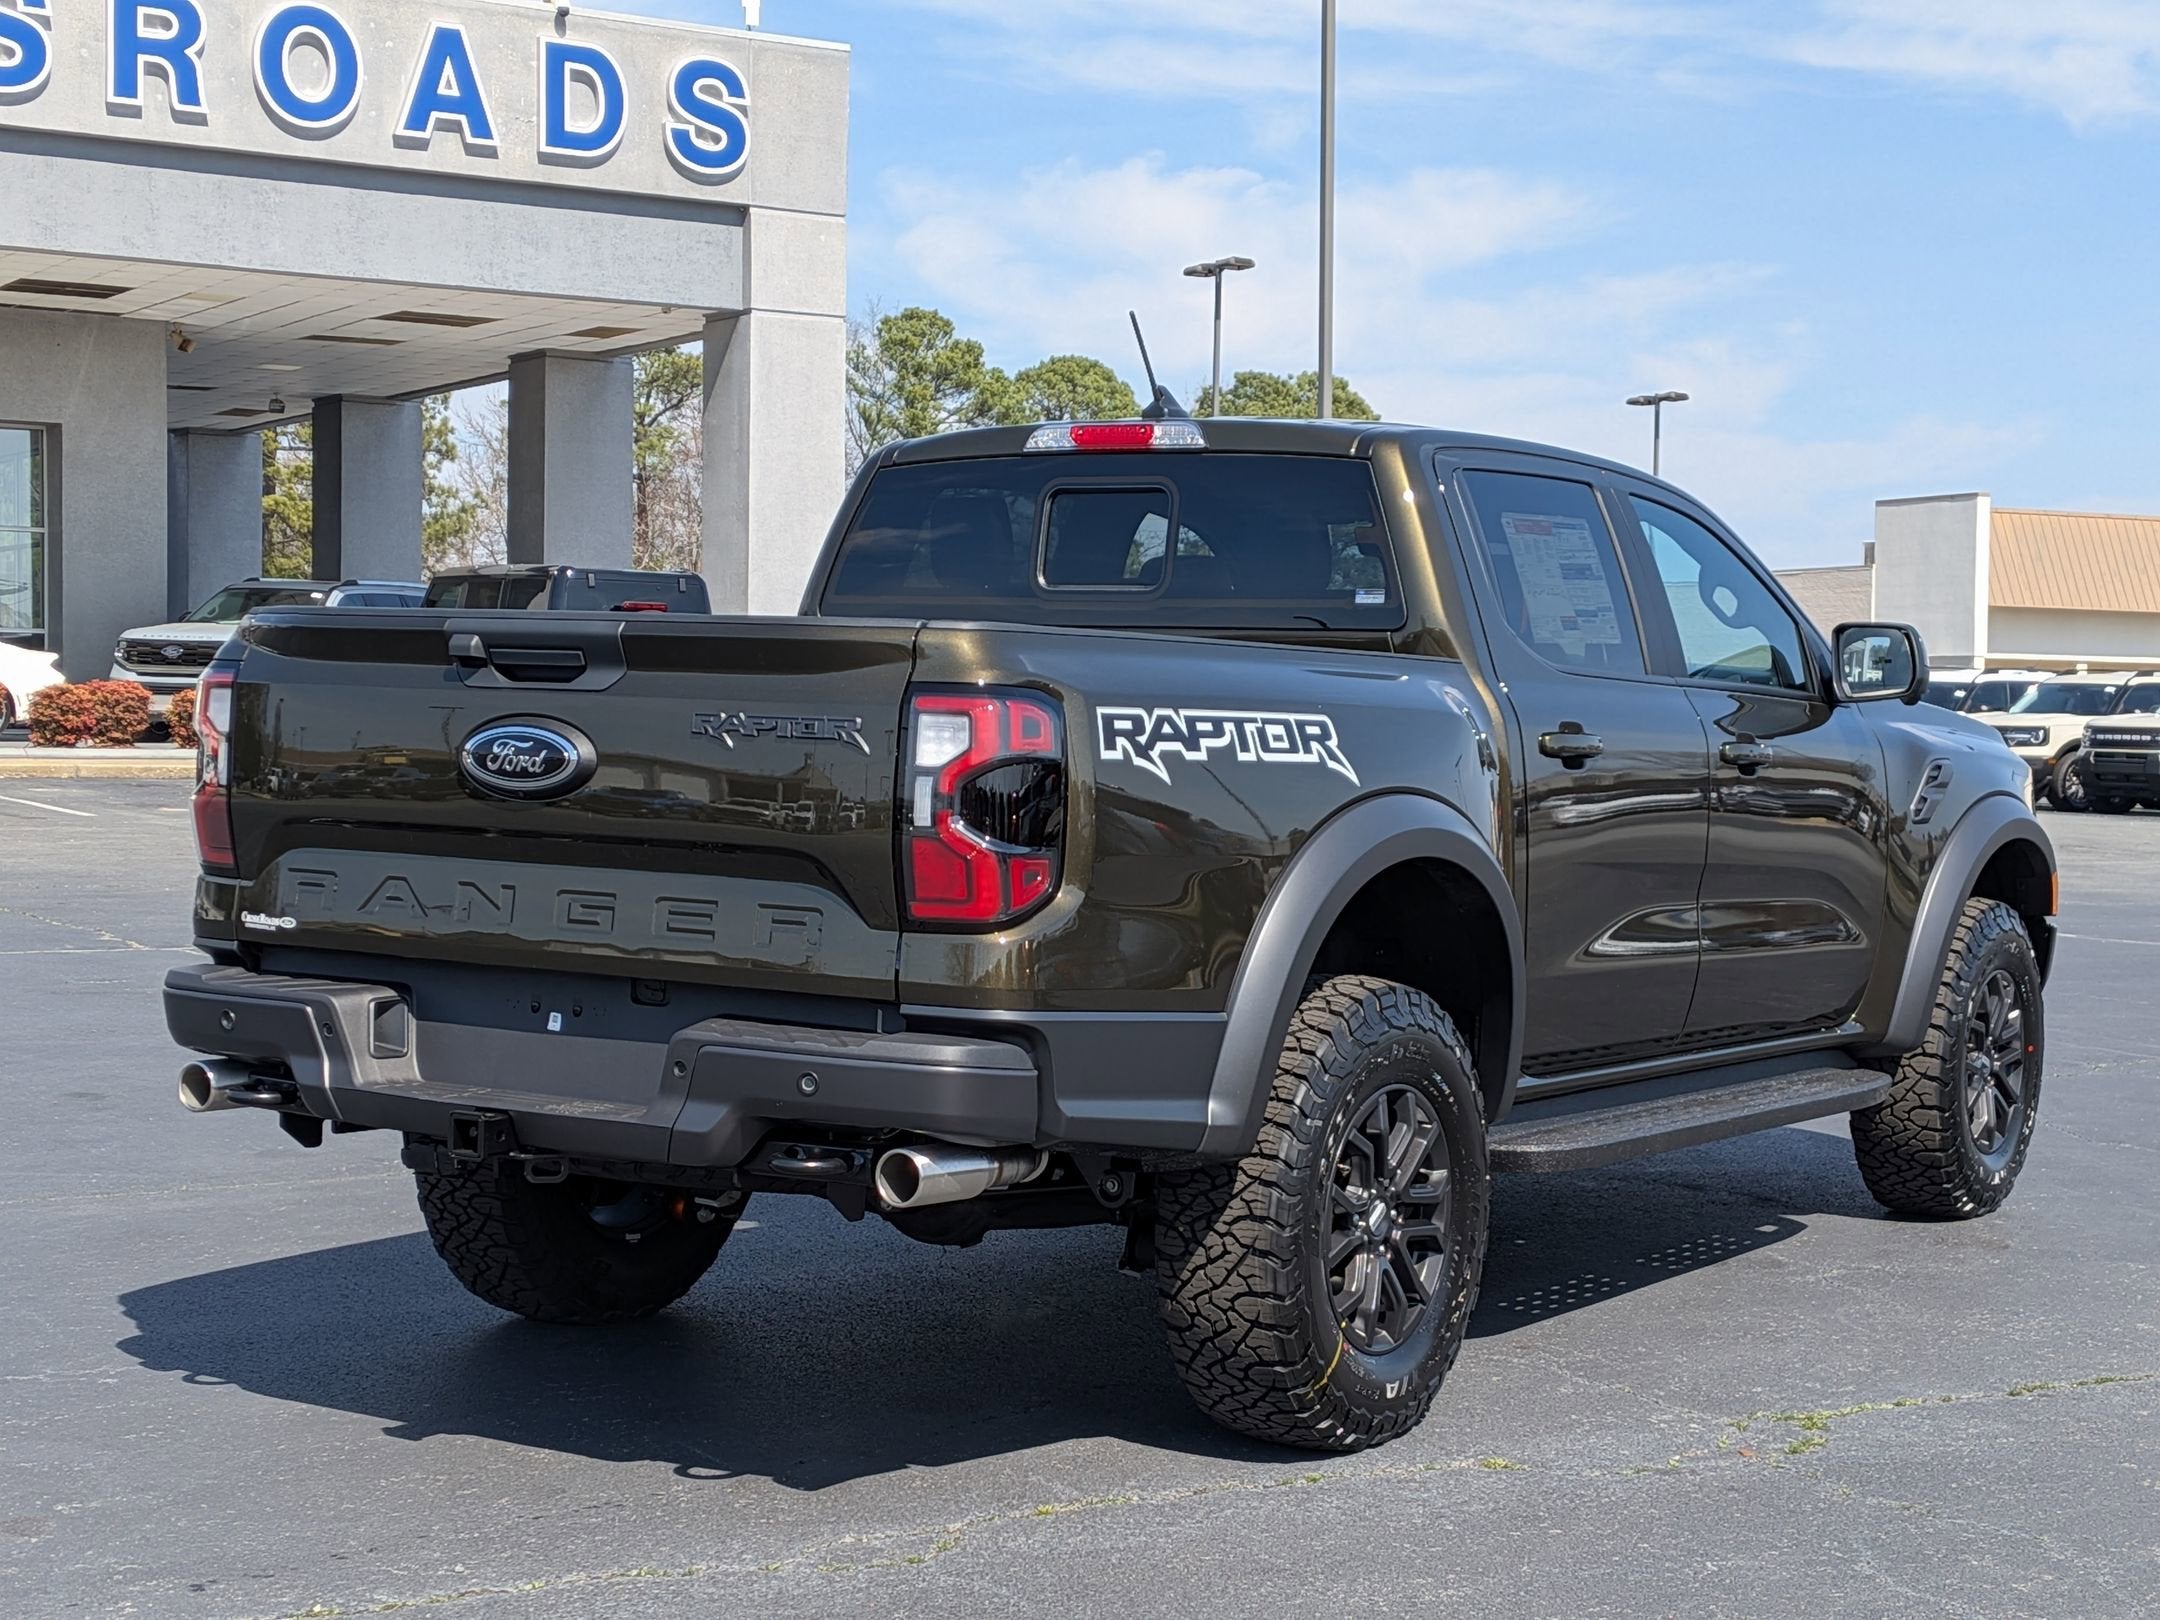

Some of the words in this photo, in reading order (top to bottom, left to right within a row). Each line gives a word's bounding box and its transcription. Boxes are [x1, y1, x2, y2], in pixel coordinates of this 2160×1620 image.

[486, 739, 548, 773] Ford
[691, 712, 870, 755] RAPTOR
[1096, 706, 1360, 786] RAPTOR
[287, 867, 824, 945] RANGER
